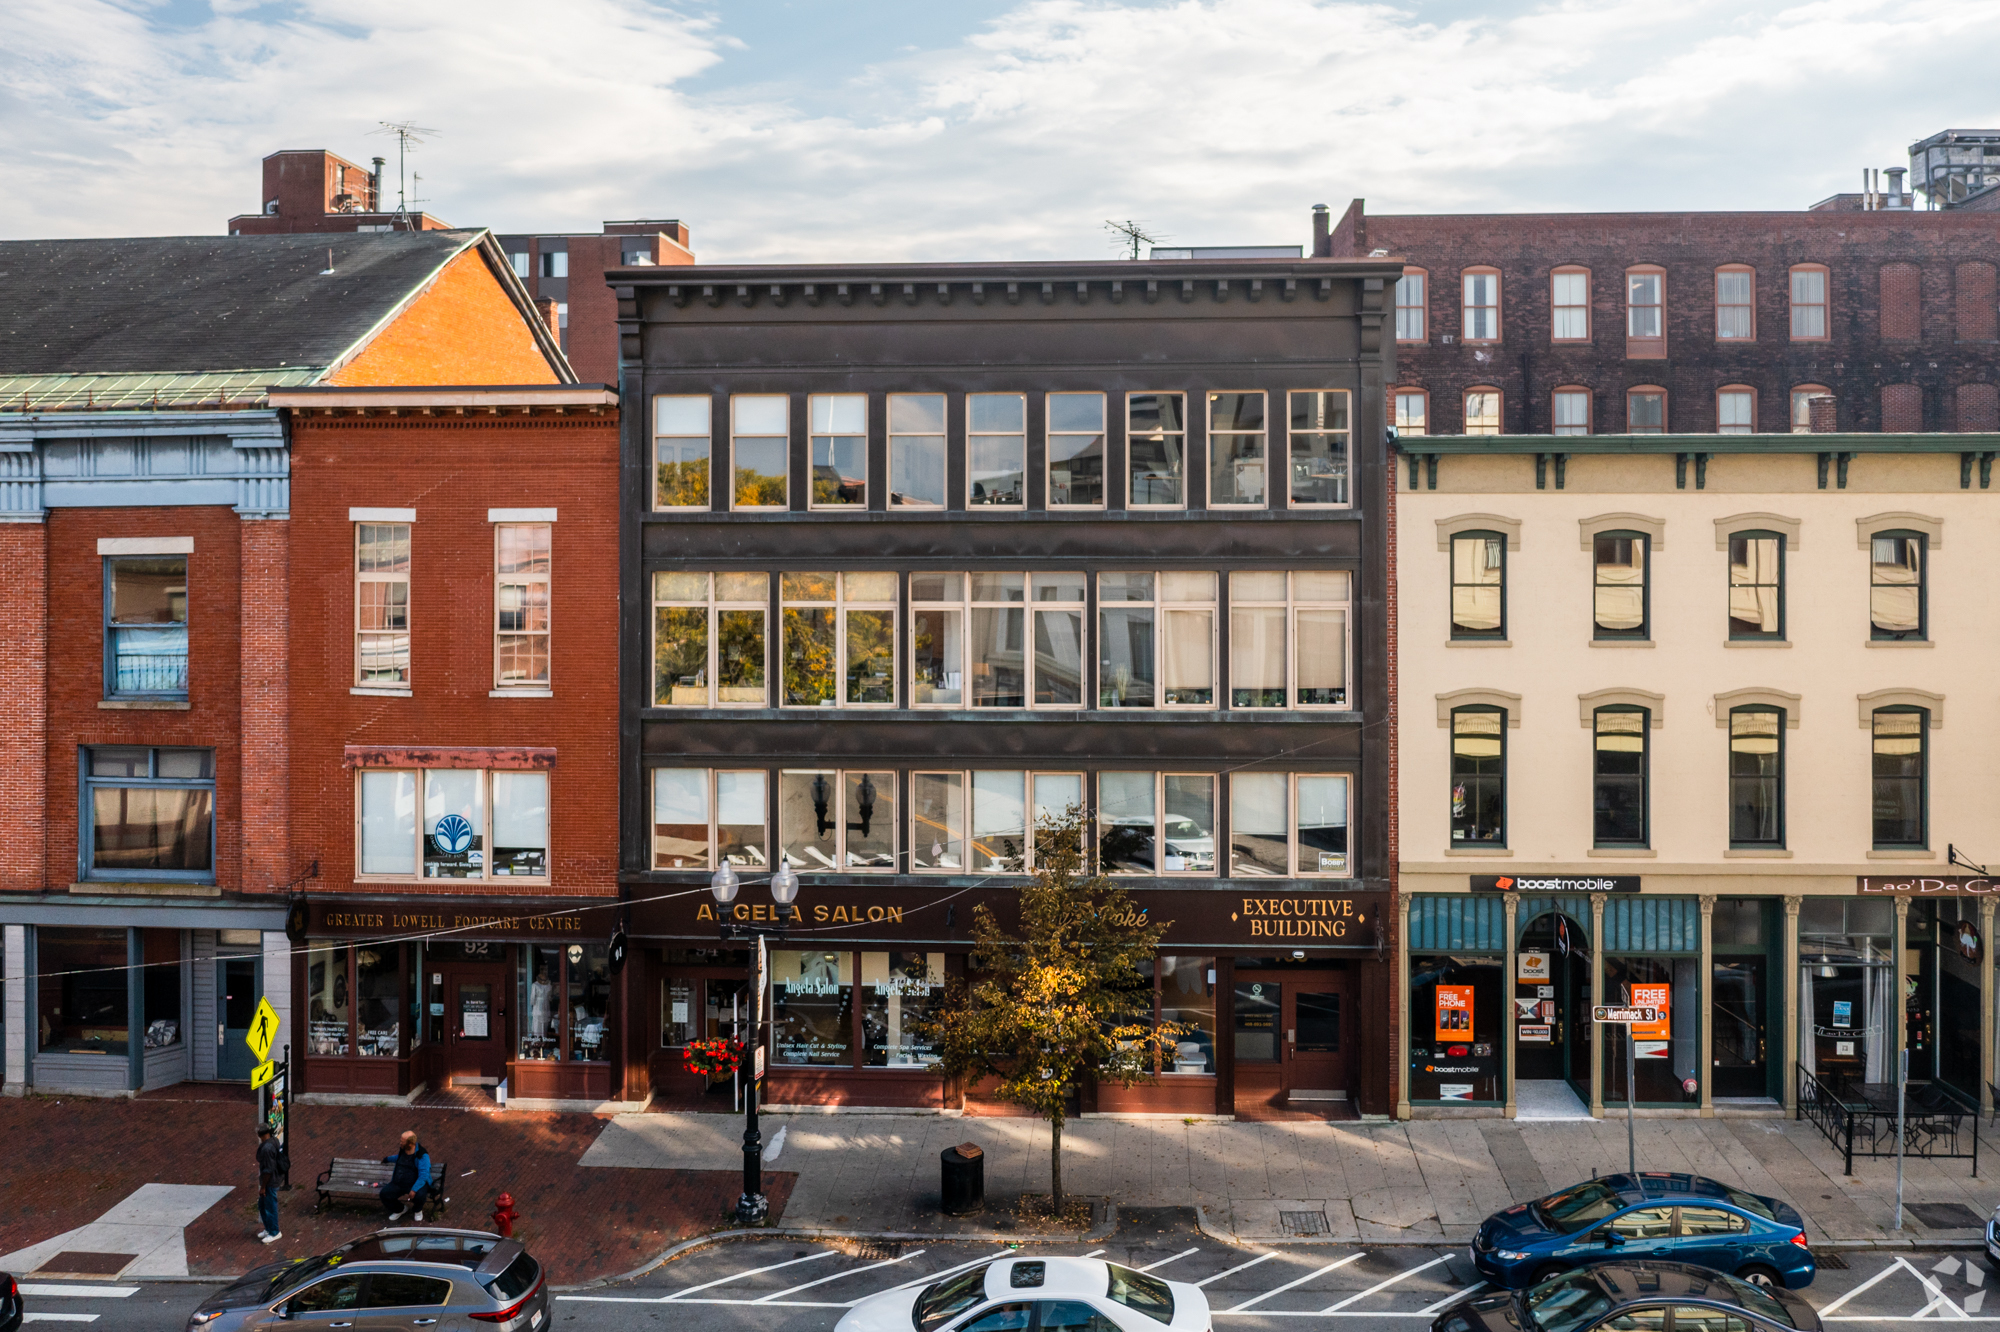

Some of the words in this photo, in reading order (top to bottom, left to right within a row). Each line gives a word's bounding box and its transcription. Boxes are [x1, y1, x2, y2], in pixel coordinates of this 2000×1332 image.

[813, 905, 903, 923] SALON
[1242, 898, 1354, 917] EXECUTIVE
[326, 913, 384, 927] GREATER
[392, 914, 446, 928] LOWELL
[454, 914, 520, 930] FOOTCARE
[529, 916, 582, 931] CENTRE
[1250, 919, 1346, 937] BUILDING
[464, 941, 489, 954] 92
[785, 977, 814, 997] Angela
[815, 977, 839, 995] Salon
[874, 978, 904, 998] Angela
[1634, 989, 1666, 999] FREE
[1607, 1008, 1643, 1020] Merrimack
[1645, 1008, 1653, 1020] St
[827, 1043, 847, 1051] Styling
[873, 1043, 898, 1051] Complete
